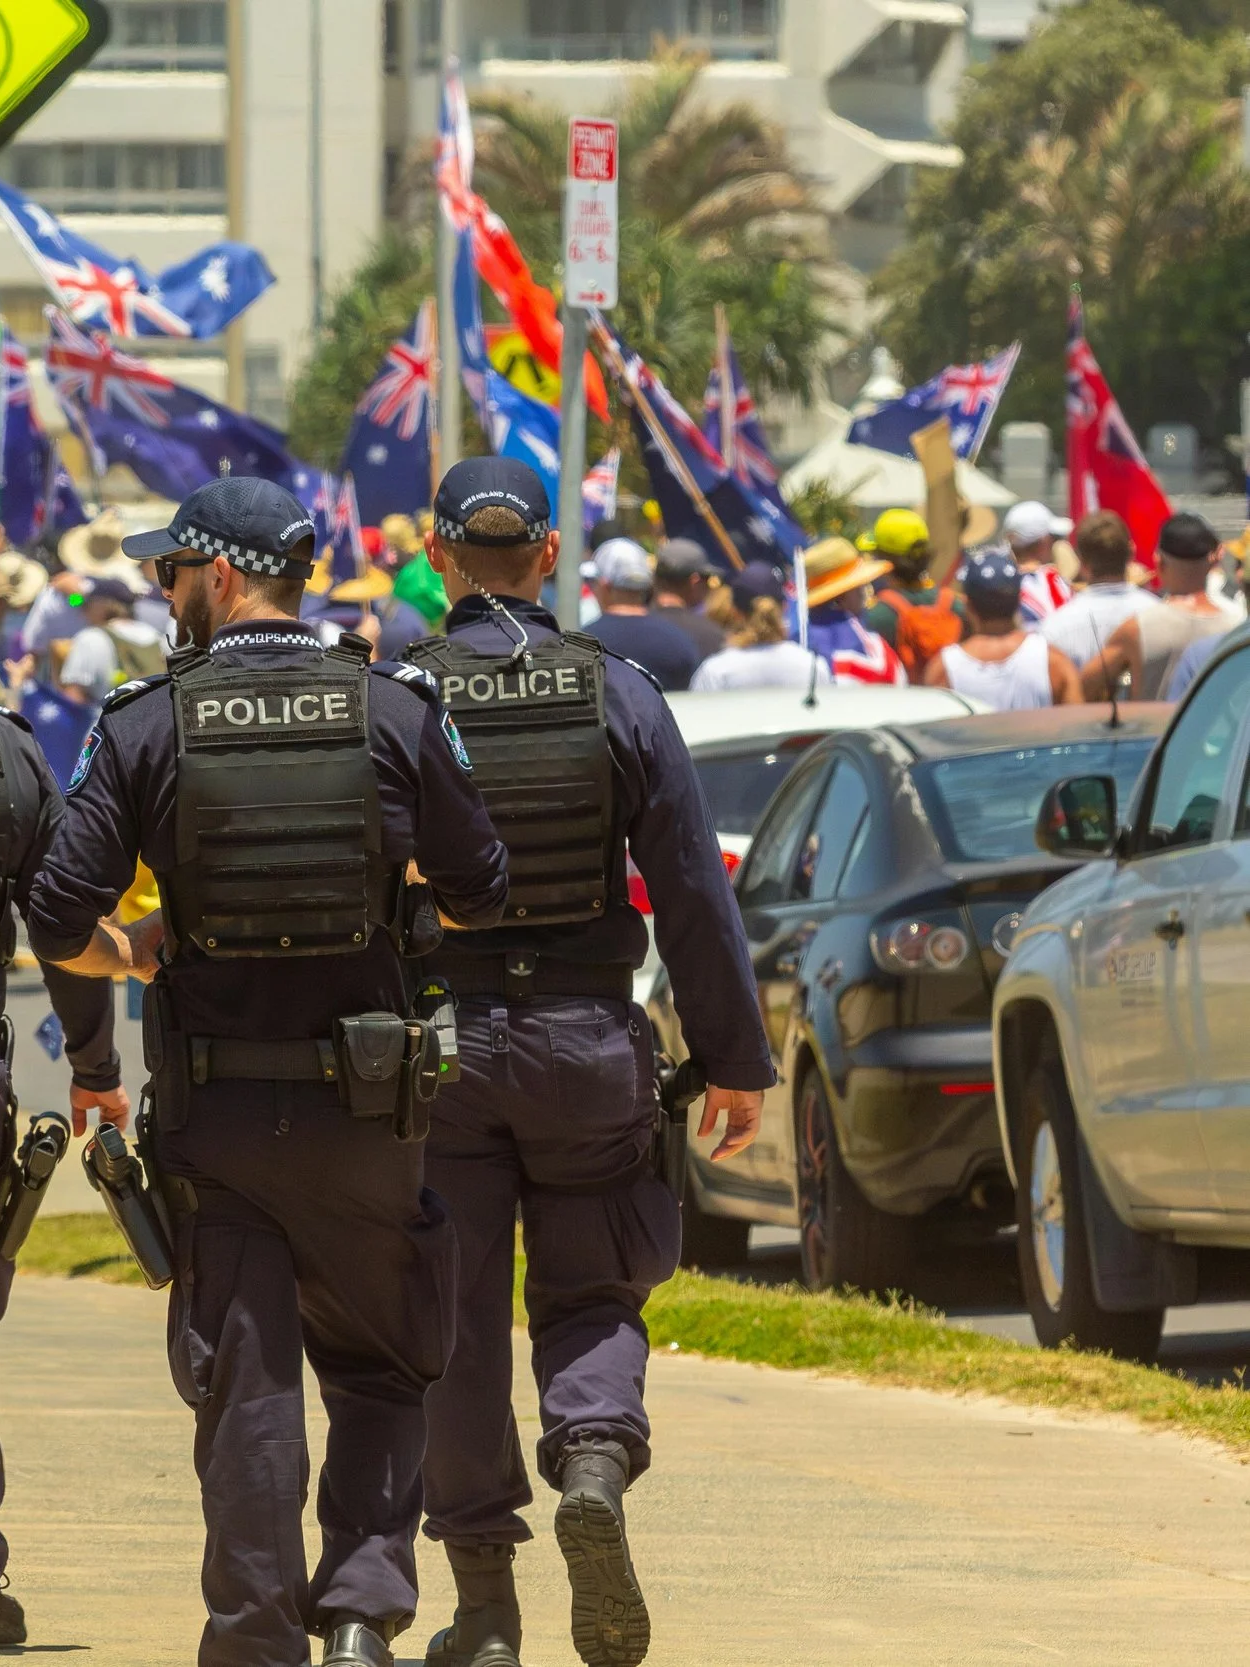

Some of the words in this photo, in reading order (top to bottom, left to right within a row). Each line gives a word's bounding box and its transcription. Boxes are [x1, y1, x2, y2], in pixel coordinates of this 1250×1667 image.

[576, 151, 610, 177] ZONE
[460, 490, 504, 510] QUEENSLAND
[506, 493, 530, 511] POLICE
[255, 633, 282, 643] QPS
[443, 667, 579, 703] POLICE
[197, 693, 349, 728] POLICE
